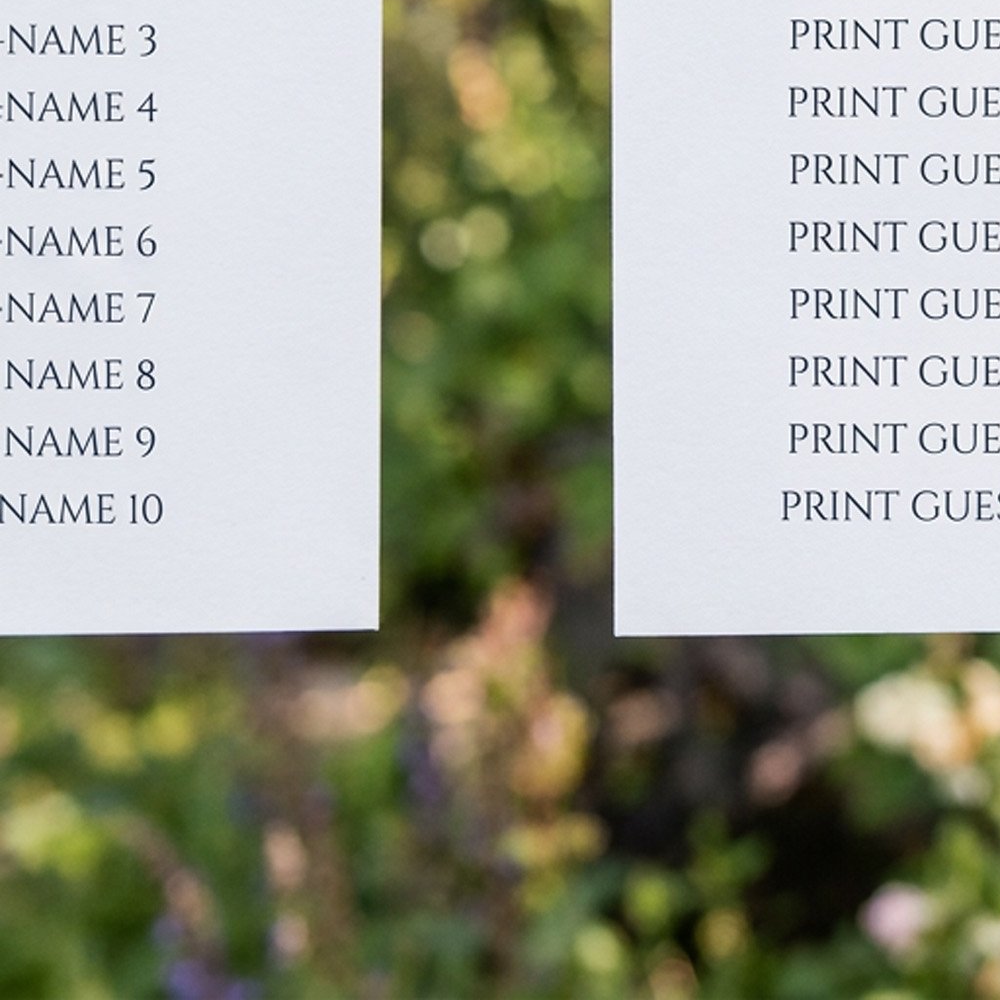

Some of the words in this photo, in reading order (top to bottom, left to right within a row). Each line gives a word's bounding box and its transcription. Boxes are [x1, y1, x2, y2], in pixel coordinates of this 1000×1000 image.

[138, 24, 157, 57] 3
[790, 18, 909, 50] PRINT
[0, 91, 124, 122] NAME
[136, 92, 158, 123] 4
[789, 86, 908, 118] PRINT
[0, 158, 125, 189] NAME
[138, 159, 156, 191] 5
[790, 153, 909, 185] PRINT
[0, 225, 124, 257] NAME
[137, 225, 157, 257] 6
[789, 221, 908, 252] PRINT
[0, 292, 124, 323] NAME
[136, 292, 156, 324] 7
[790, 288, 909, 320] PRINT
[6, 359, 124, 390] NAME
[136, 358, 156, 391] 8
[789, 355, 908, 387] PRINT
[5, 426, 123, 457] NAME
[135, 426, 156, 458] 9
[789, 423, 908, 454] PRINT
[0, 493, 116, 525] NAME
[130, 493, 163, 525] 10
[782, 490, 900, 521] PRINT
